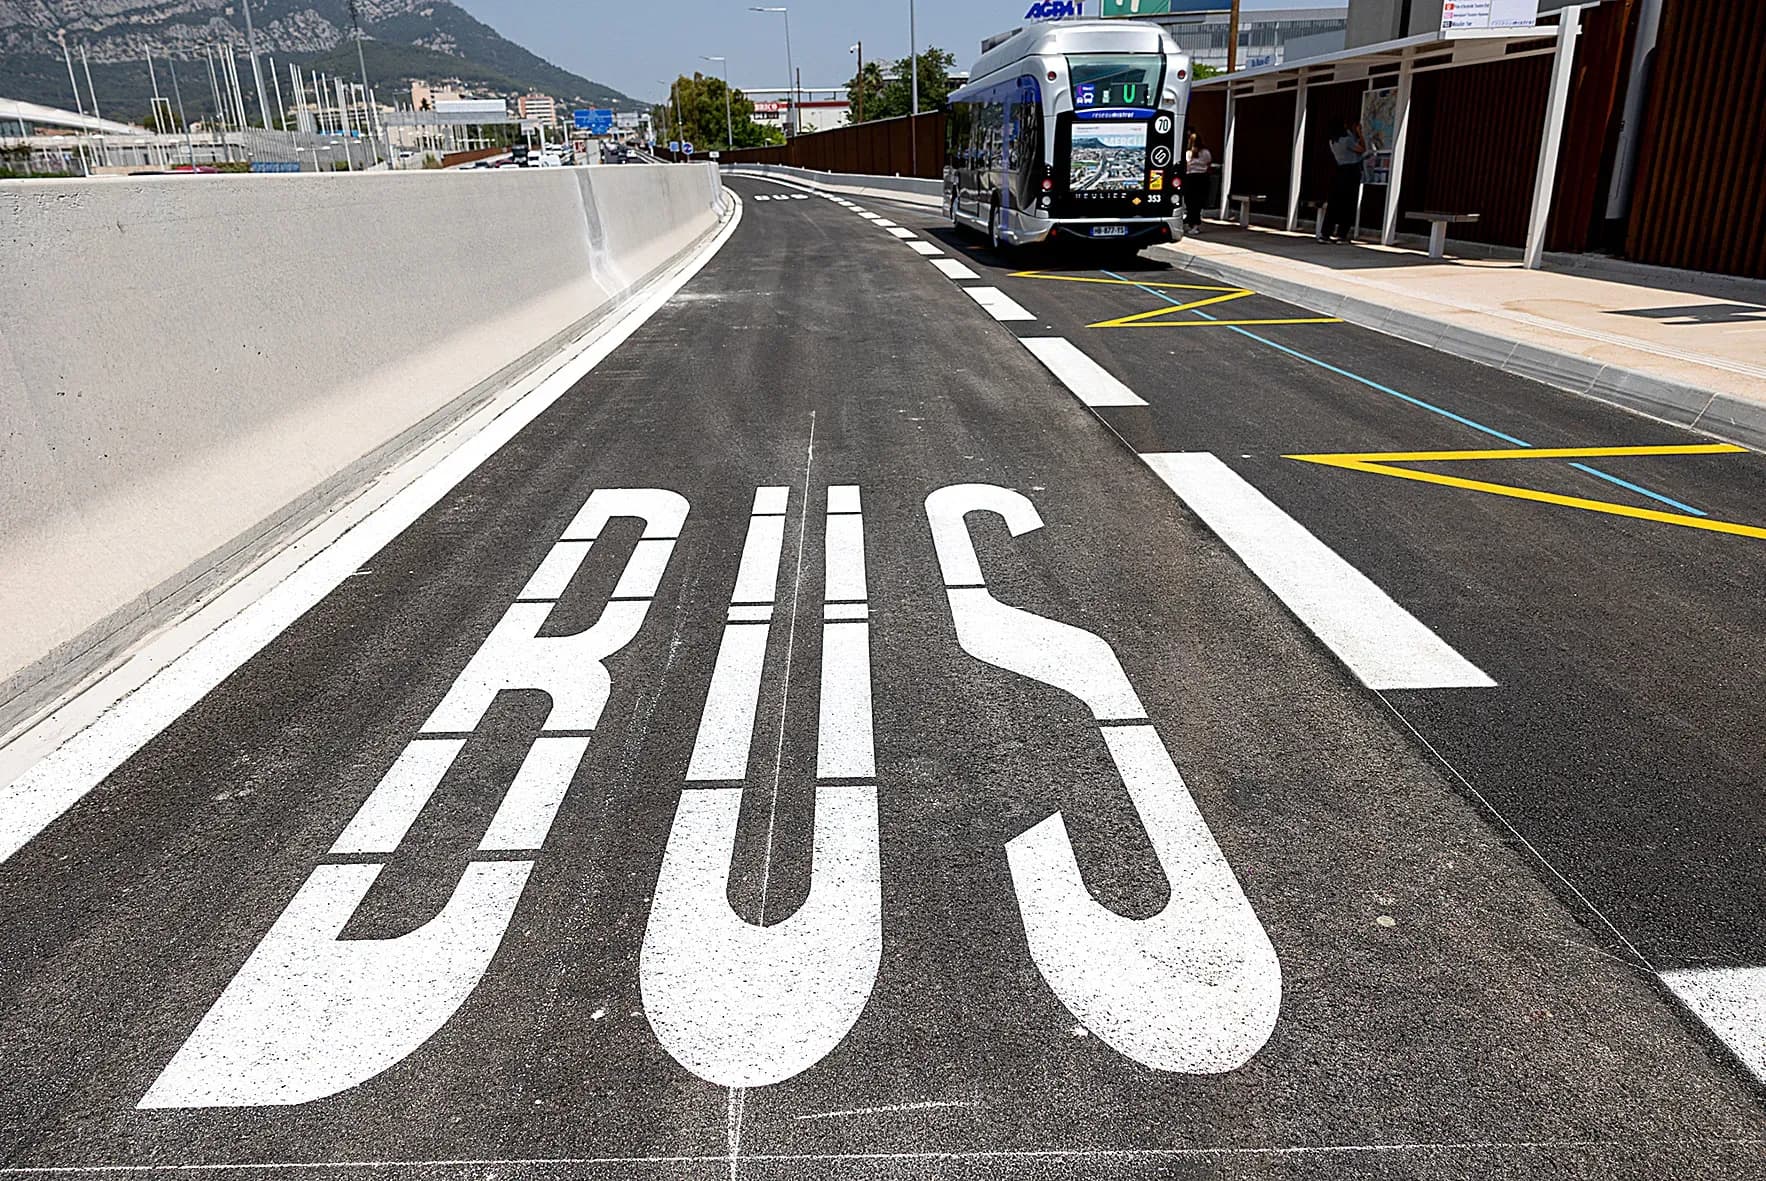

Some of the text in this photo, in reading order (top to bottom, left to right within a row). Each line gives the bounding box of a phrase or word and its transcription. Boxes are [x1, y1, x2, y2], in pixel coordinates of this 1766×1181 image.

[1123, 83, 1135, 104] U
[1158, 119, 1169, 131] 70
[754, 193, 808, 201] BUS
[1147, 194, 1161, 204] 353
[136, 484, 1283, 1110] BUS
